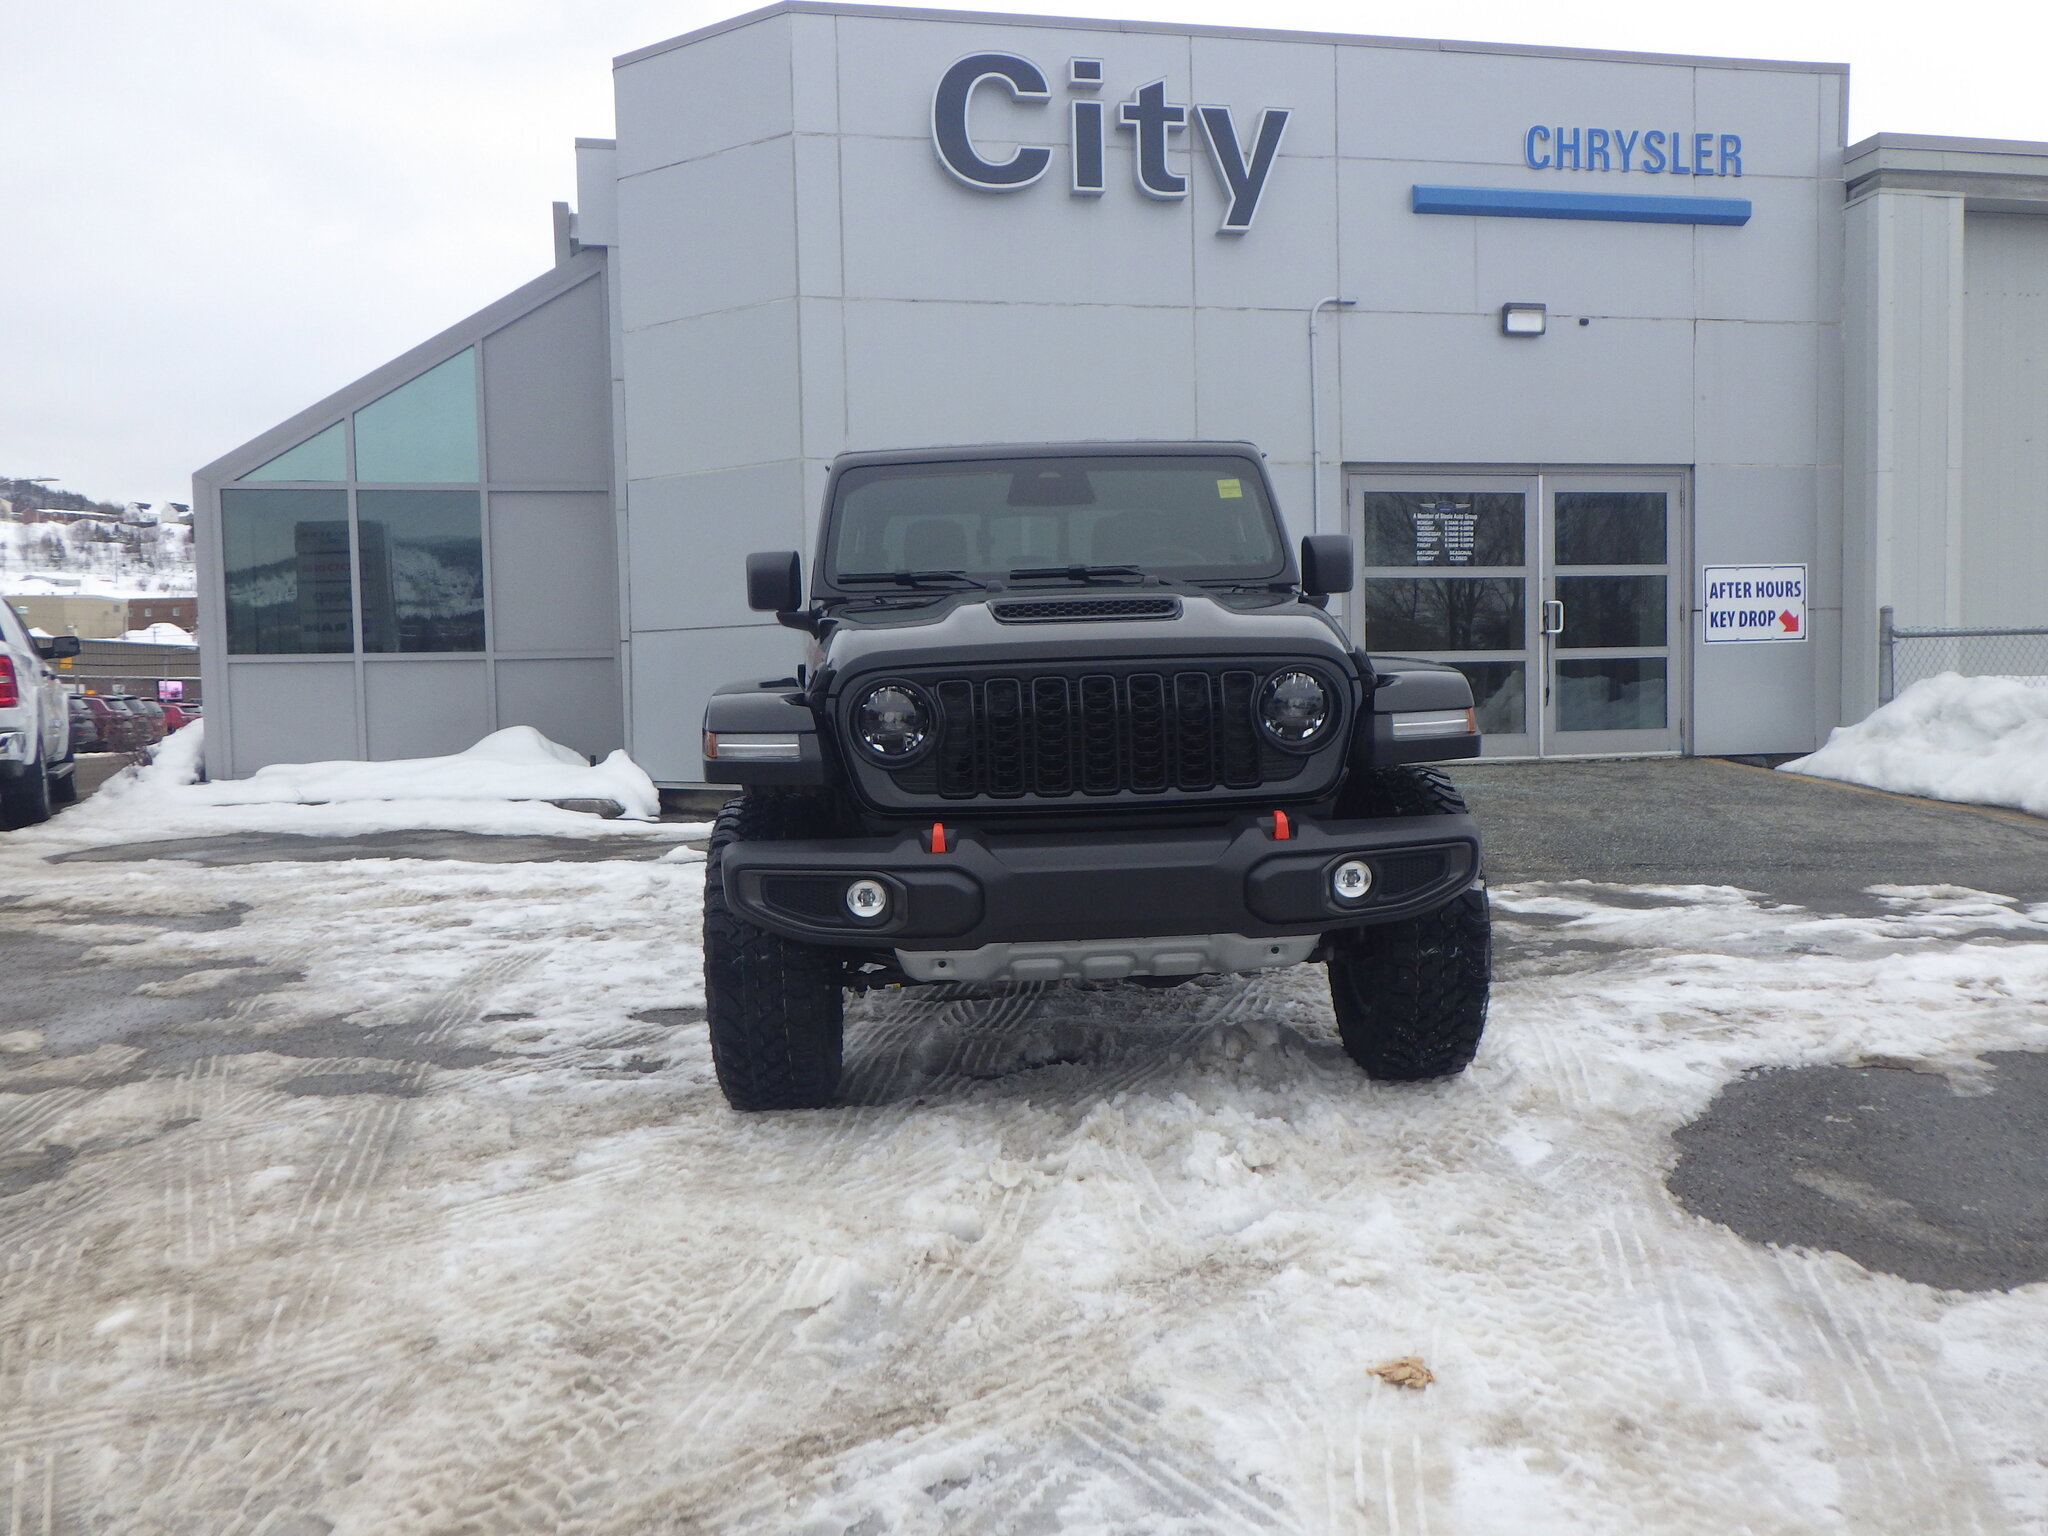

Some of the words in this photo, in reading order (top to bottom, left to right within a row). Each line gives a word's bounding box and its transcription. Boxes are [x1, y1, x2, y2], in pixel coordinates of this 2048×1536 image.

[930, 50, 1294, 235] City
[1524, 125, 1743, 177] CHRYSLER
[1710, 581, 1752, 599] AFTER
[1756, 580, 1802, 598] HOURS
[1710, 610, 1736, 628] KEY
[1739, 610, 1776, 628] DROP
